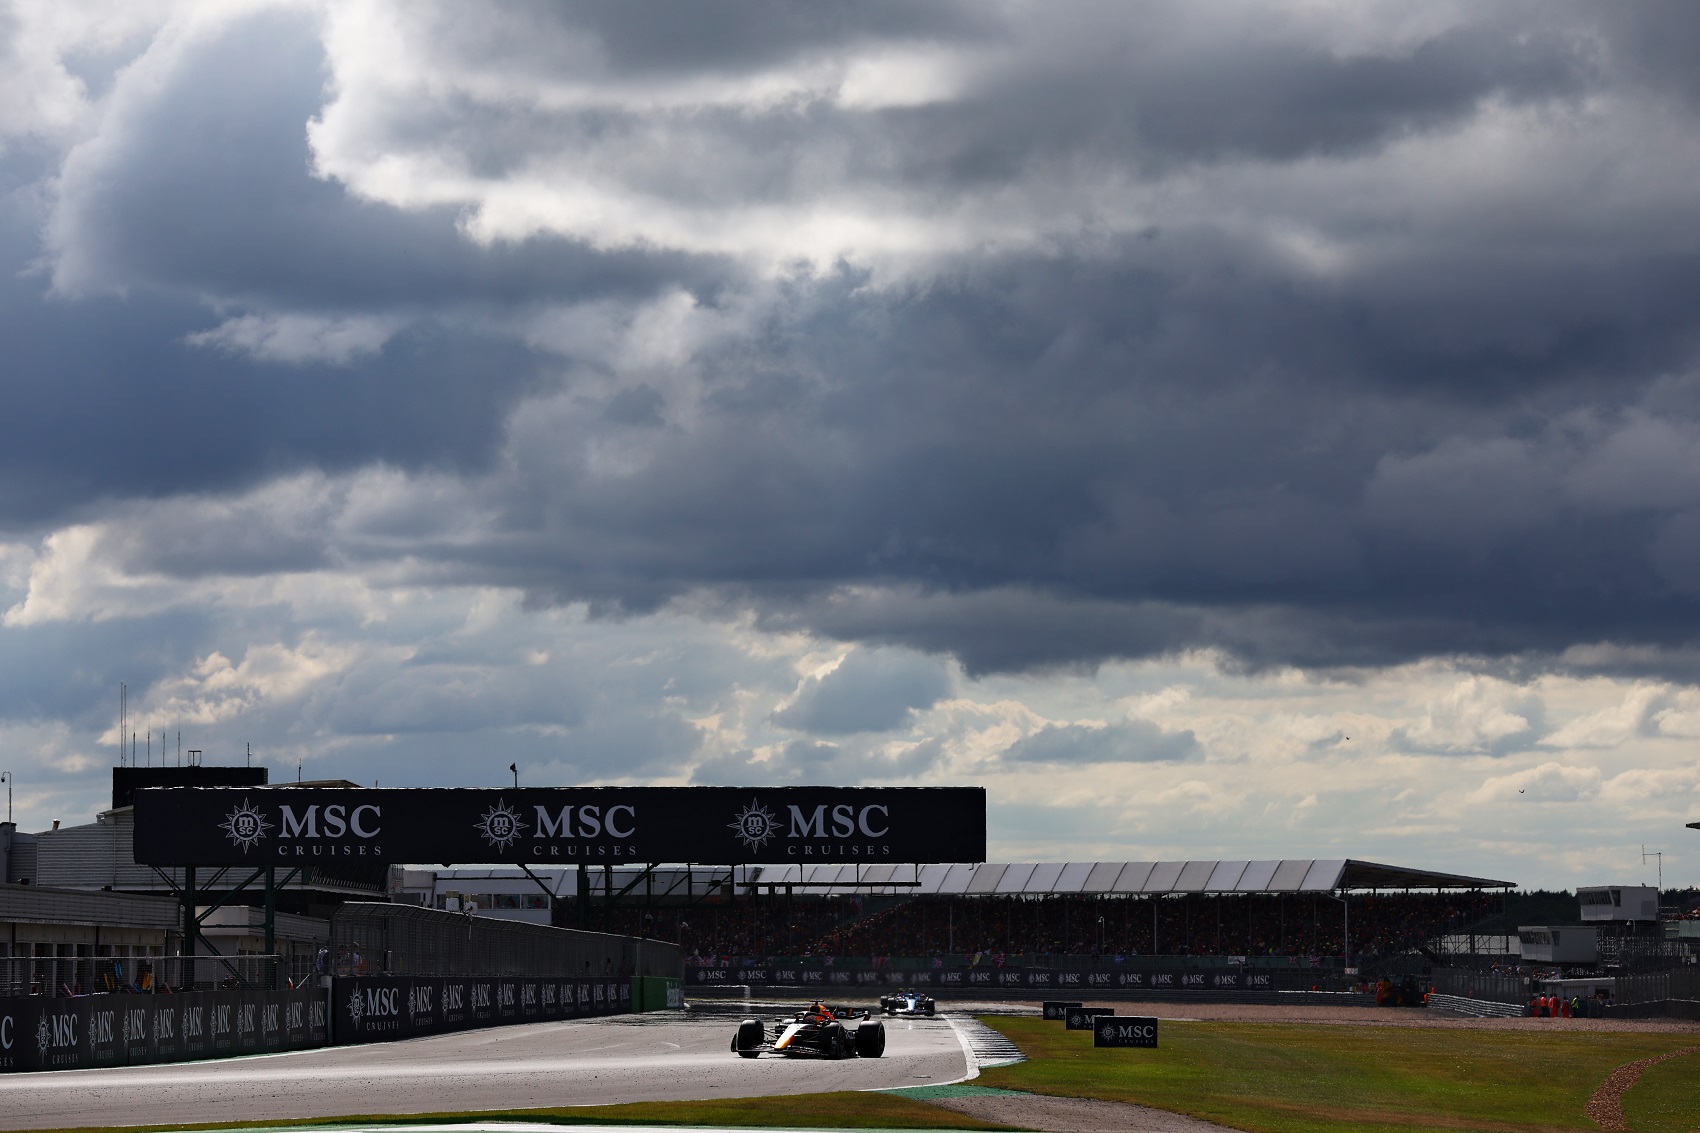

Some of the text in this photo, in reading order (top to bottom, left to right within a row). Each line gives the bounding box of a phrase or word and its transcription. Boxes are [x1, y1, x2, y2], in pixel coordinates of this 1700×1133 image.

[278, 804, 381, 838] MSC
[533, 804, 635, 838] MSC
[787, 804, 889, 838] MSC
[278, 845, 381, 855] CRUISES
[533, 845, 636, 855] CRUISES
[787, 845, 890, 855] CRUISES
[707, 970, 726, 979] MSC
[748, 970, 766, 979] MSC
[782, 971, 795, 980] MSC
[976, 973, 990, 981] MSC
[1006, 973, 1020, 982] MSC
[1035, 973, 1049, 982] MSC
[1066, 974, 1080, 982] MSC
[1096, 974, 1111, 982] MSC
[1127, 974, 1141, 982] MSC
[1158, 975, 1172, 983] MSC
[1189, 975, 1204, 983] MSC
[1221, 975, 1236, 984] MSC
[1254, 975, 1269, 984] MSC
[416, 986, 432, 1012] MSC
[449, 985, 463, 1009] MSC
[478, 984, 490, 1006] MSC
[367, 988, 398, 1016] MSC
[217, 1004, 230, 1033] MSC
[244, 1004, 255, 1032] MSC
[267, 1004, 279, 1031] MSC
[292, 1002, 303, 1028] MSC
[314, 1001, 325, 1026] MSC
[98, 1011, 114, 1042] MSC
[130, 1009, 146, 1040] MSC
[160, 1008, 174, 1038] MSC
[189, 1006, 203, 1036] MSC
[367, 1021, 399, 1031] CRUISES
[52, 1014, 77, 1046] MSC
[1118, 1026, 1154, 1038] MSC
[52, 1054, 78, 1064] CRUISES
